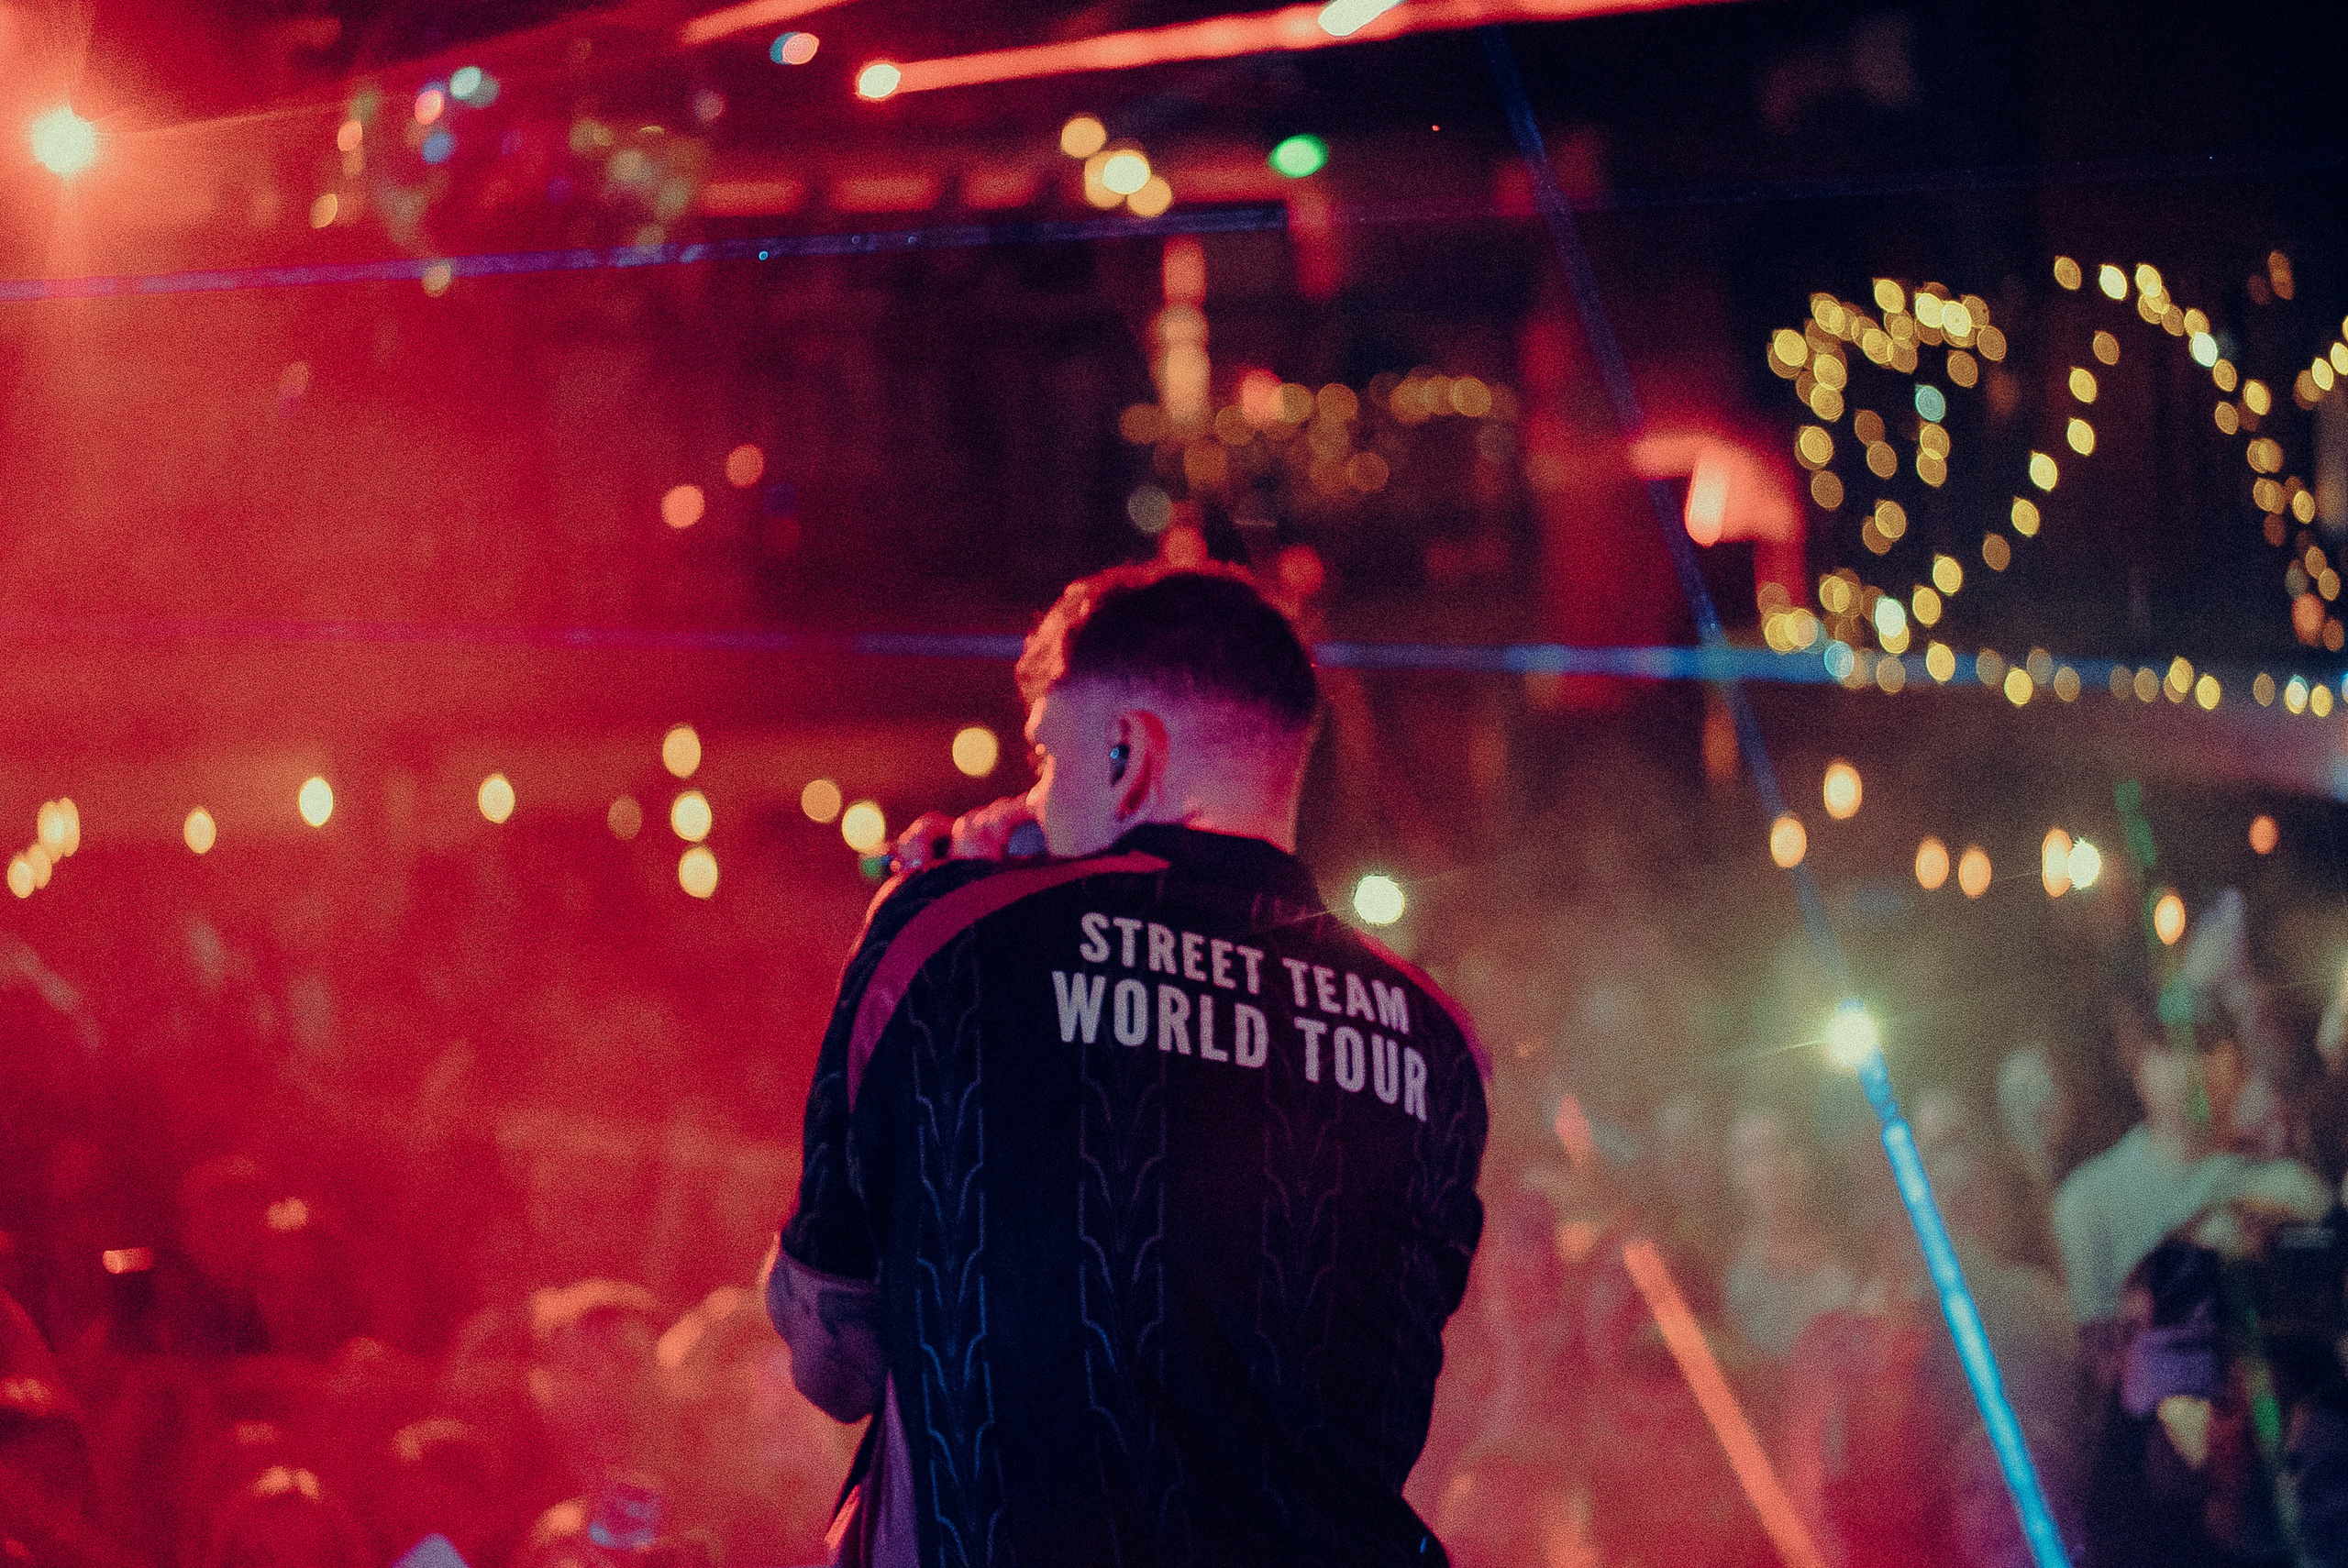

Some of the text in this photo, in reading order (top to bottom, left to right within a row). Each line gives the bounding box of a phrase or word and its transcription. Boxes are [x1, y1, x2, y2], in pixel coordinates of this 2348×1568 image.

[1080, 912, 1410, 1034] STREET TEAM
[1052, 970, 1428, 1121] WORLD TOUR
